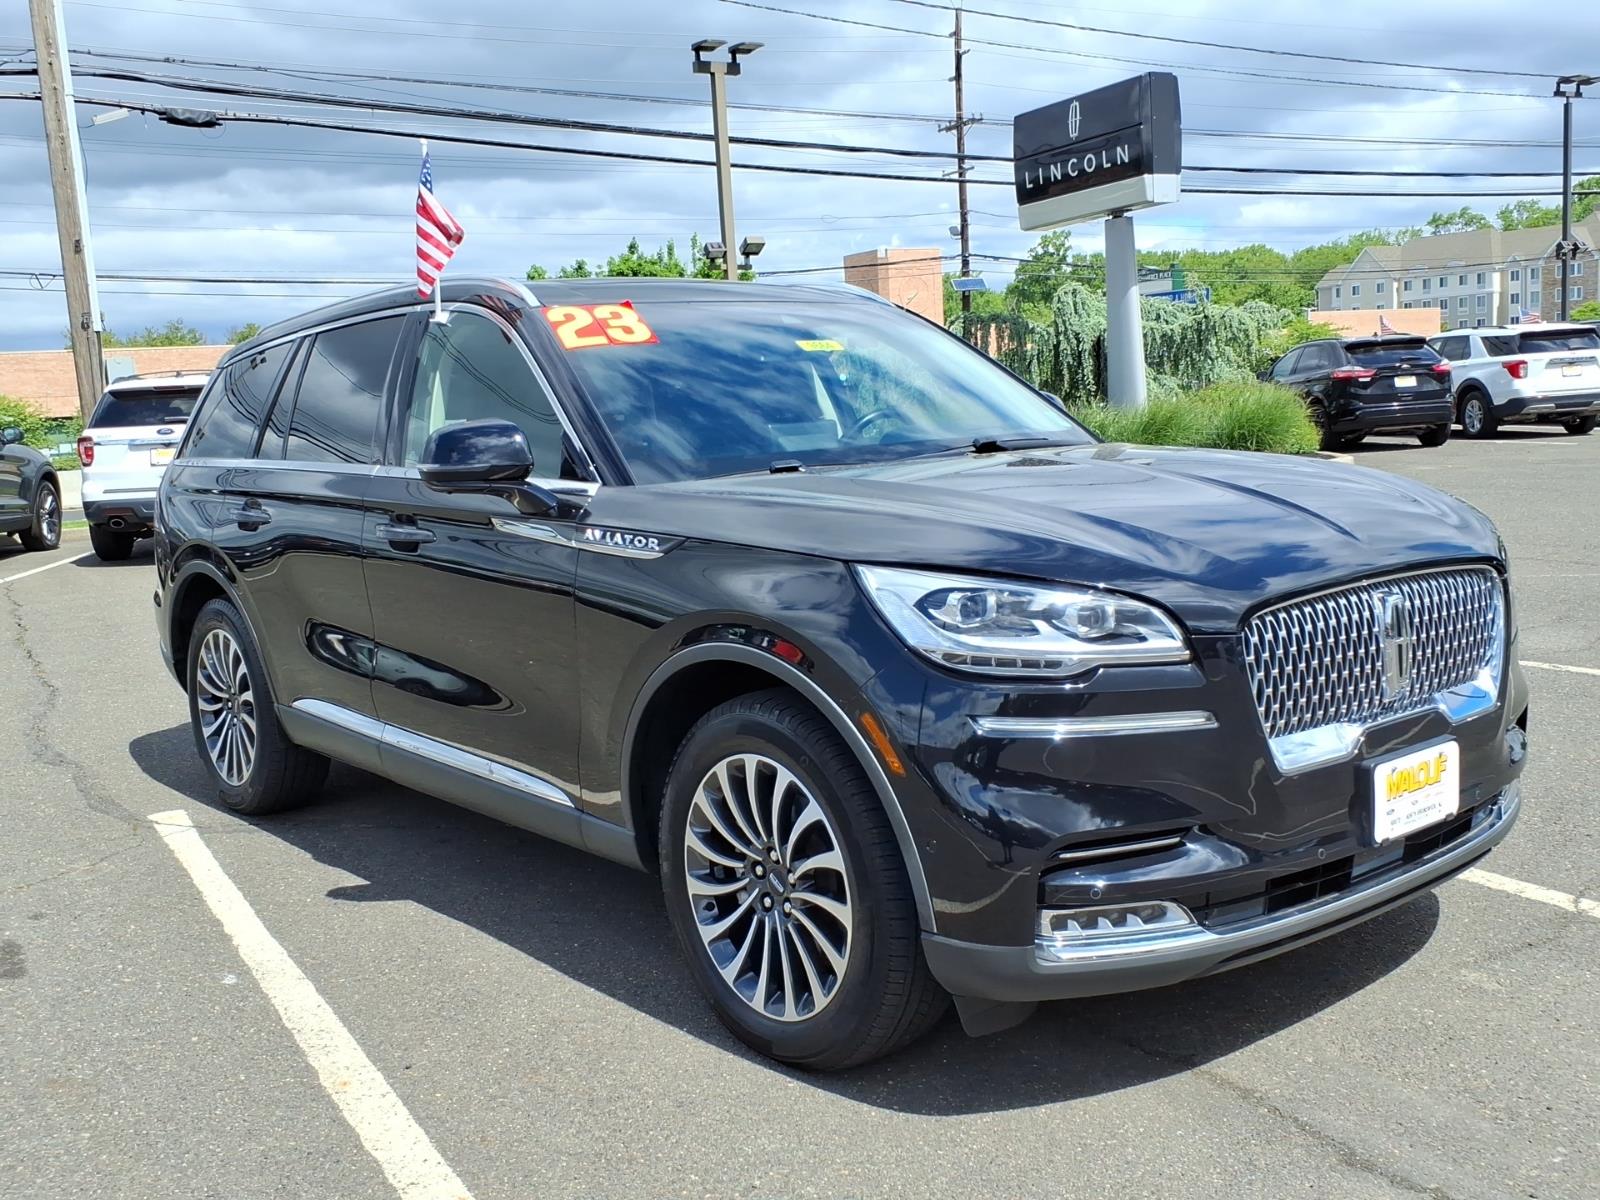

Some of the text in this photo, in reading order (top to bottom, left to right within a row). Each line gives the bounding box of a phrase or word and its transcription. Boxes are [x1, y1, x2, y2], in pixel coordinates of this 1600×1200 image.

[1025, 144, 1129, 189] LINCOLN
[546, 304, 652, 350] 23
[583, 528, 660, 551] AVIATOR
[1384, 752, 1448, 802] MALOUF
